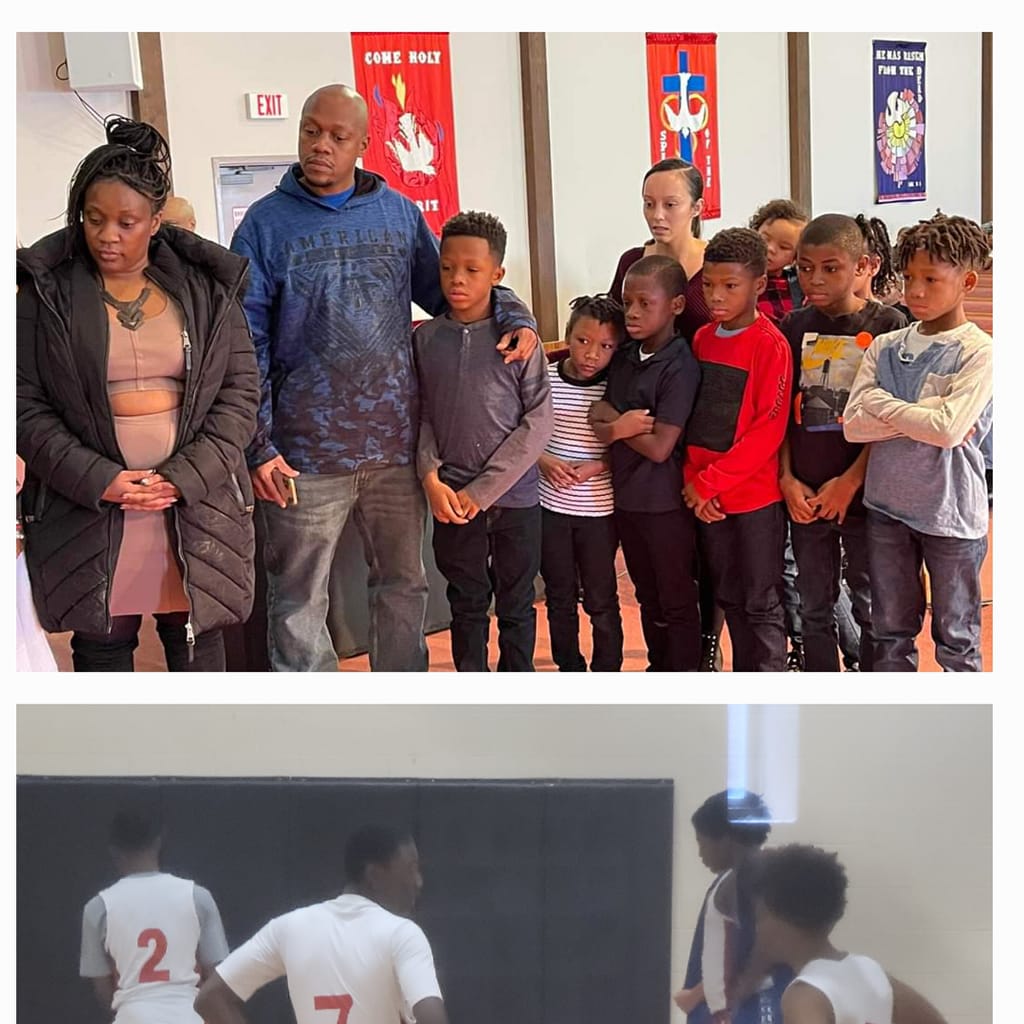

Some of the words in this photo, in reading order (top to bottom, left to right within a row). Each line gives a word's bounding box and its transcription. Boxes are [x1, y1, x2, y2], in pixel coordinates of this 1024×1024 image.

[364, 51, 402, 65] COME
[409, 51, 442, 65] HOLY
[257, 94, 282, 116] EXIT
[283, 228, 409, 258] AMERICAN
[137, 928, 170, 983] 2
